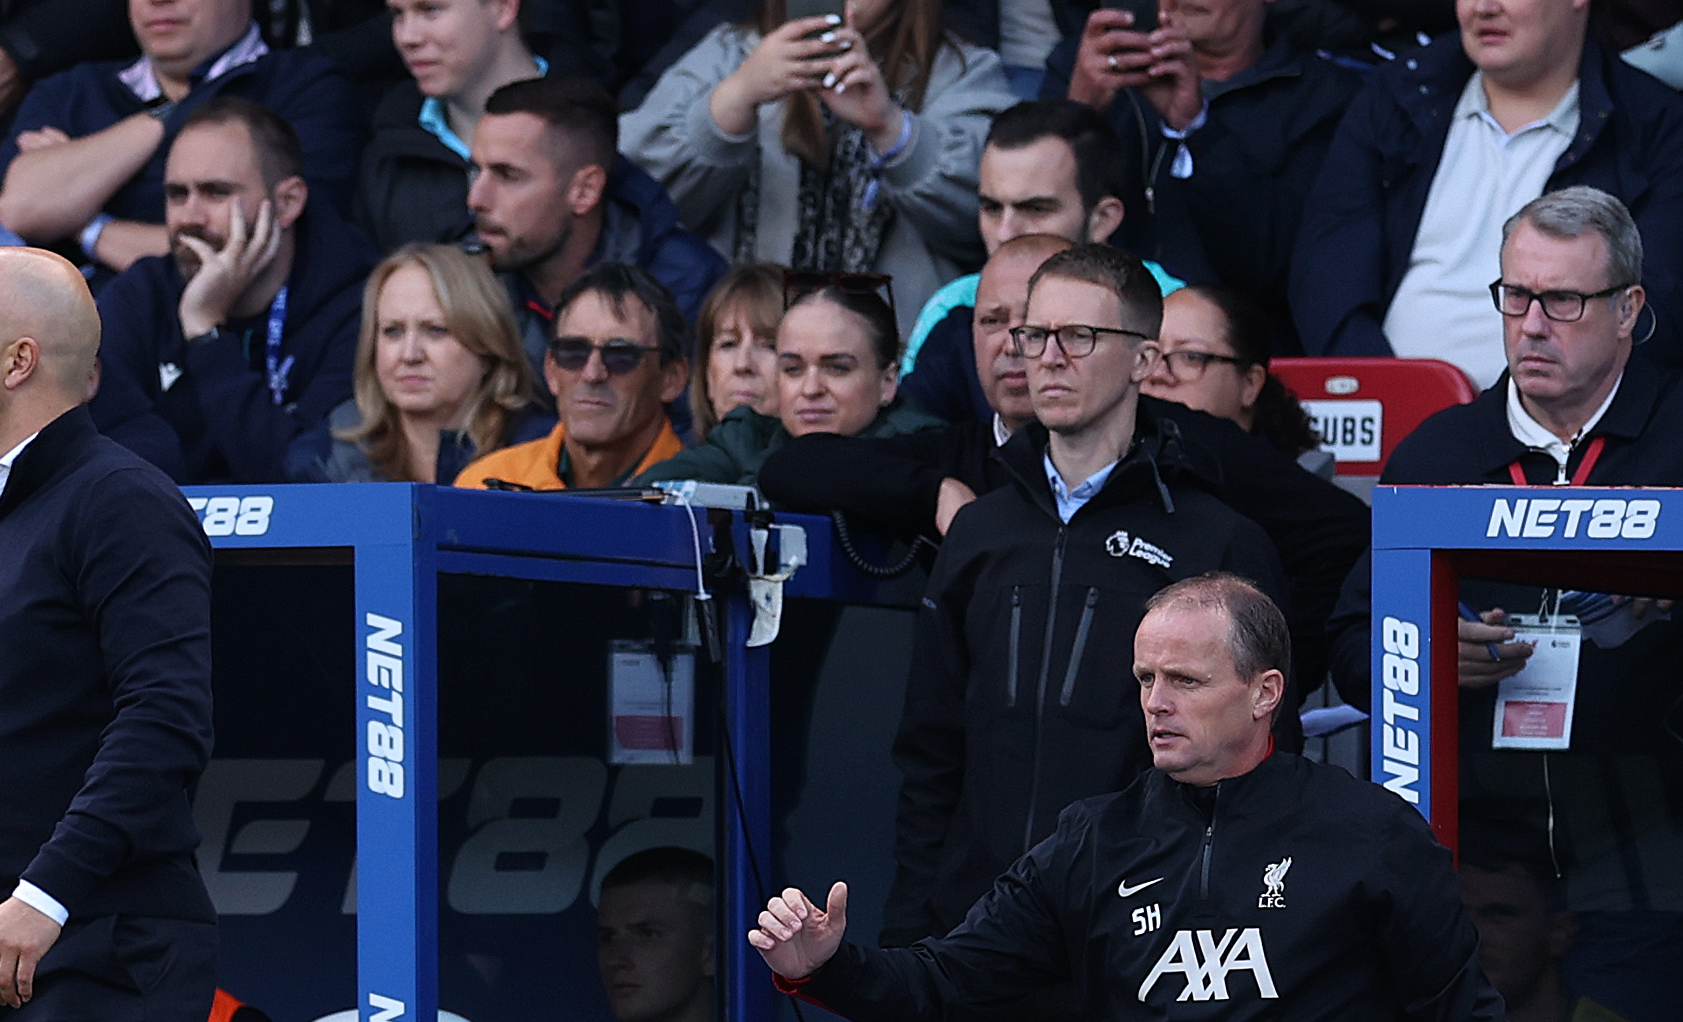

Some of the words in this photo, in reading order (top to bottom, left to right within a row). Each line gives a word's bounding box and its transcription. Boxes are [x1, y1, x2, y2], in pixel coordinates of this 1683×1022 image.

[1487, 499, 1660, 538] NET88
[366, 612, 404, 799] NET88
[1383, 616, 1419, 804] NET88
[1131, 903, 1161, 936] SH
[1138, 927, 1279, 1002] AXA
